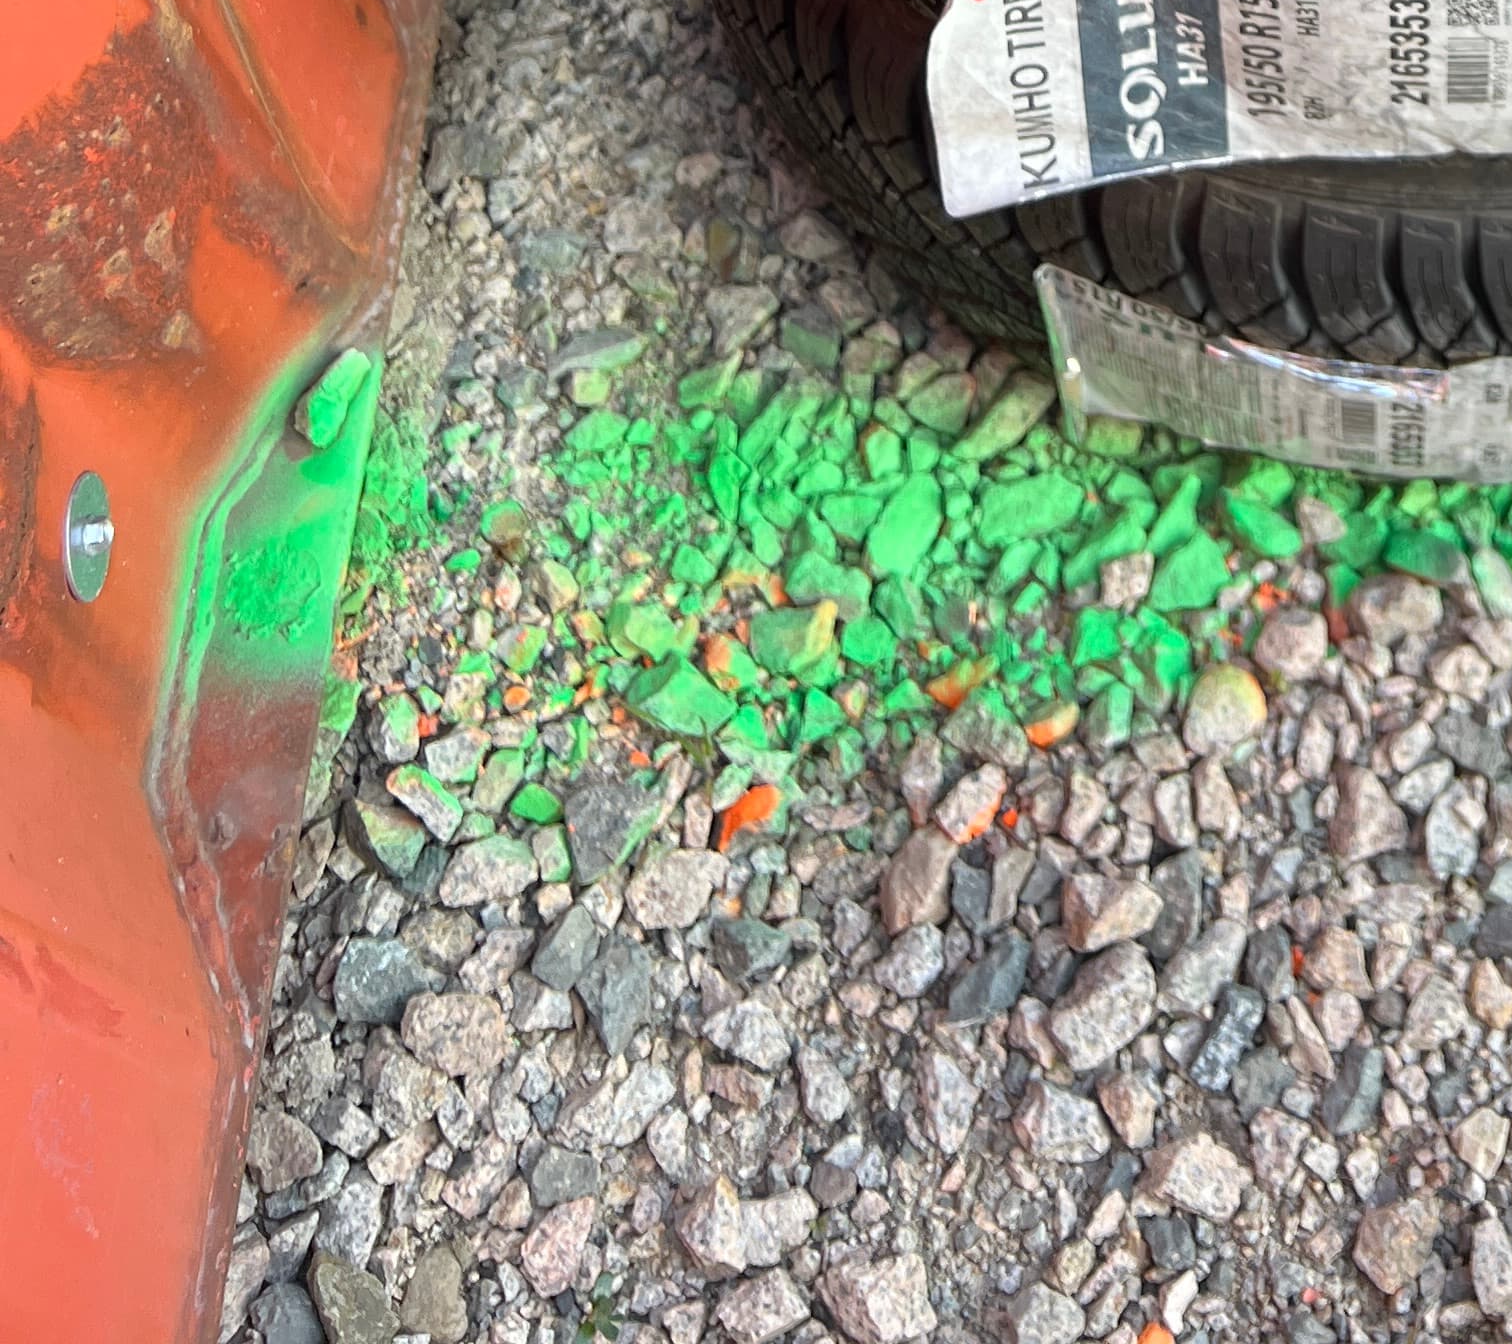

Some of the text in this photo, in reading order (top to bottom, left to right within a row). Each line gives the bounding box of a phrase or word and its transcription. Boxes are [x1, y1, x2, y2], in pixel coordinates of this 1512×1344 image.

[1174, 11, 1210, 87] HA31
[1295, 0, 1321, 40] HA31
[1244, 43, 1291, 119] 195/50
[1010, 61, 1061, 190] KUMHO
